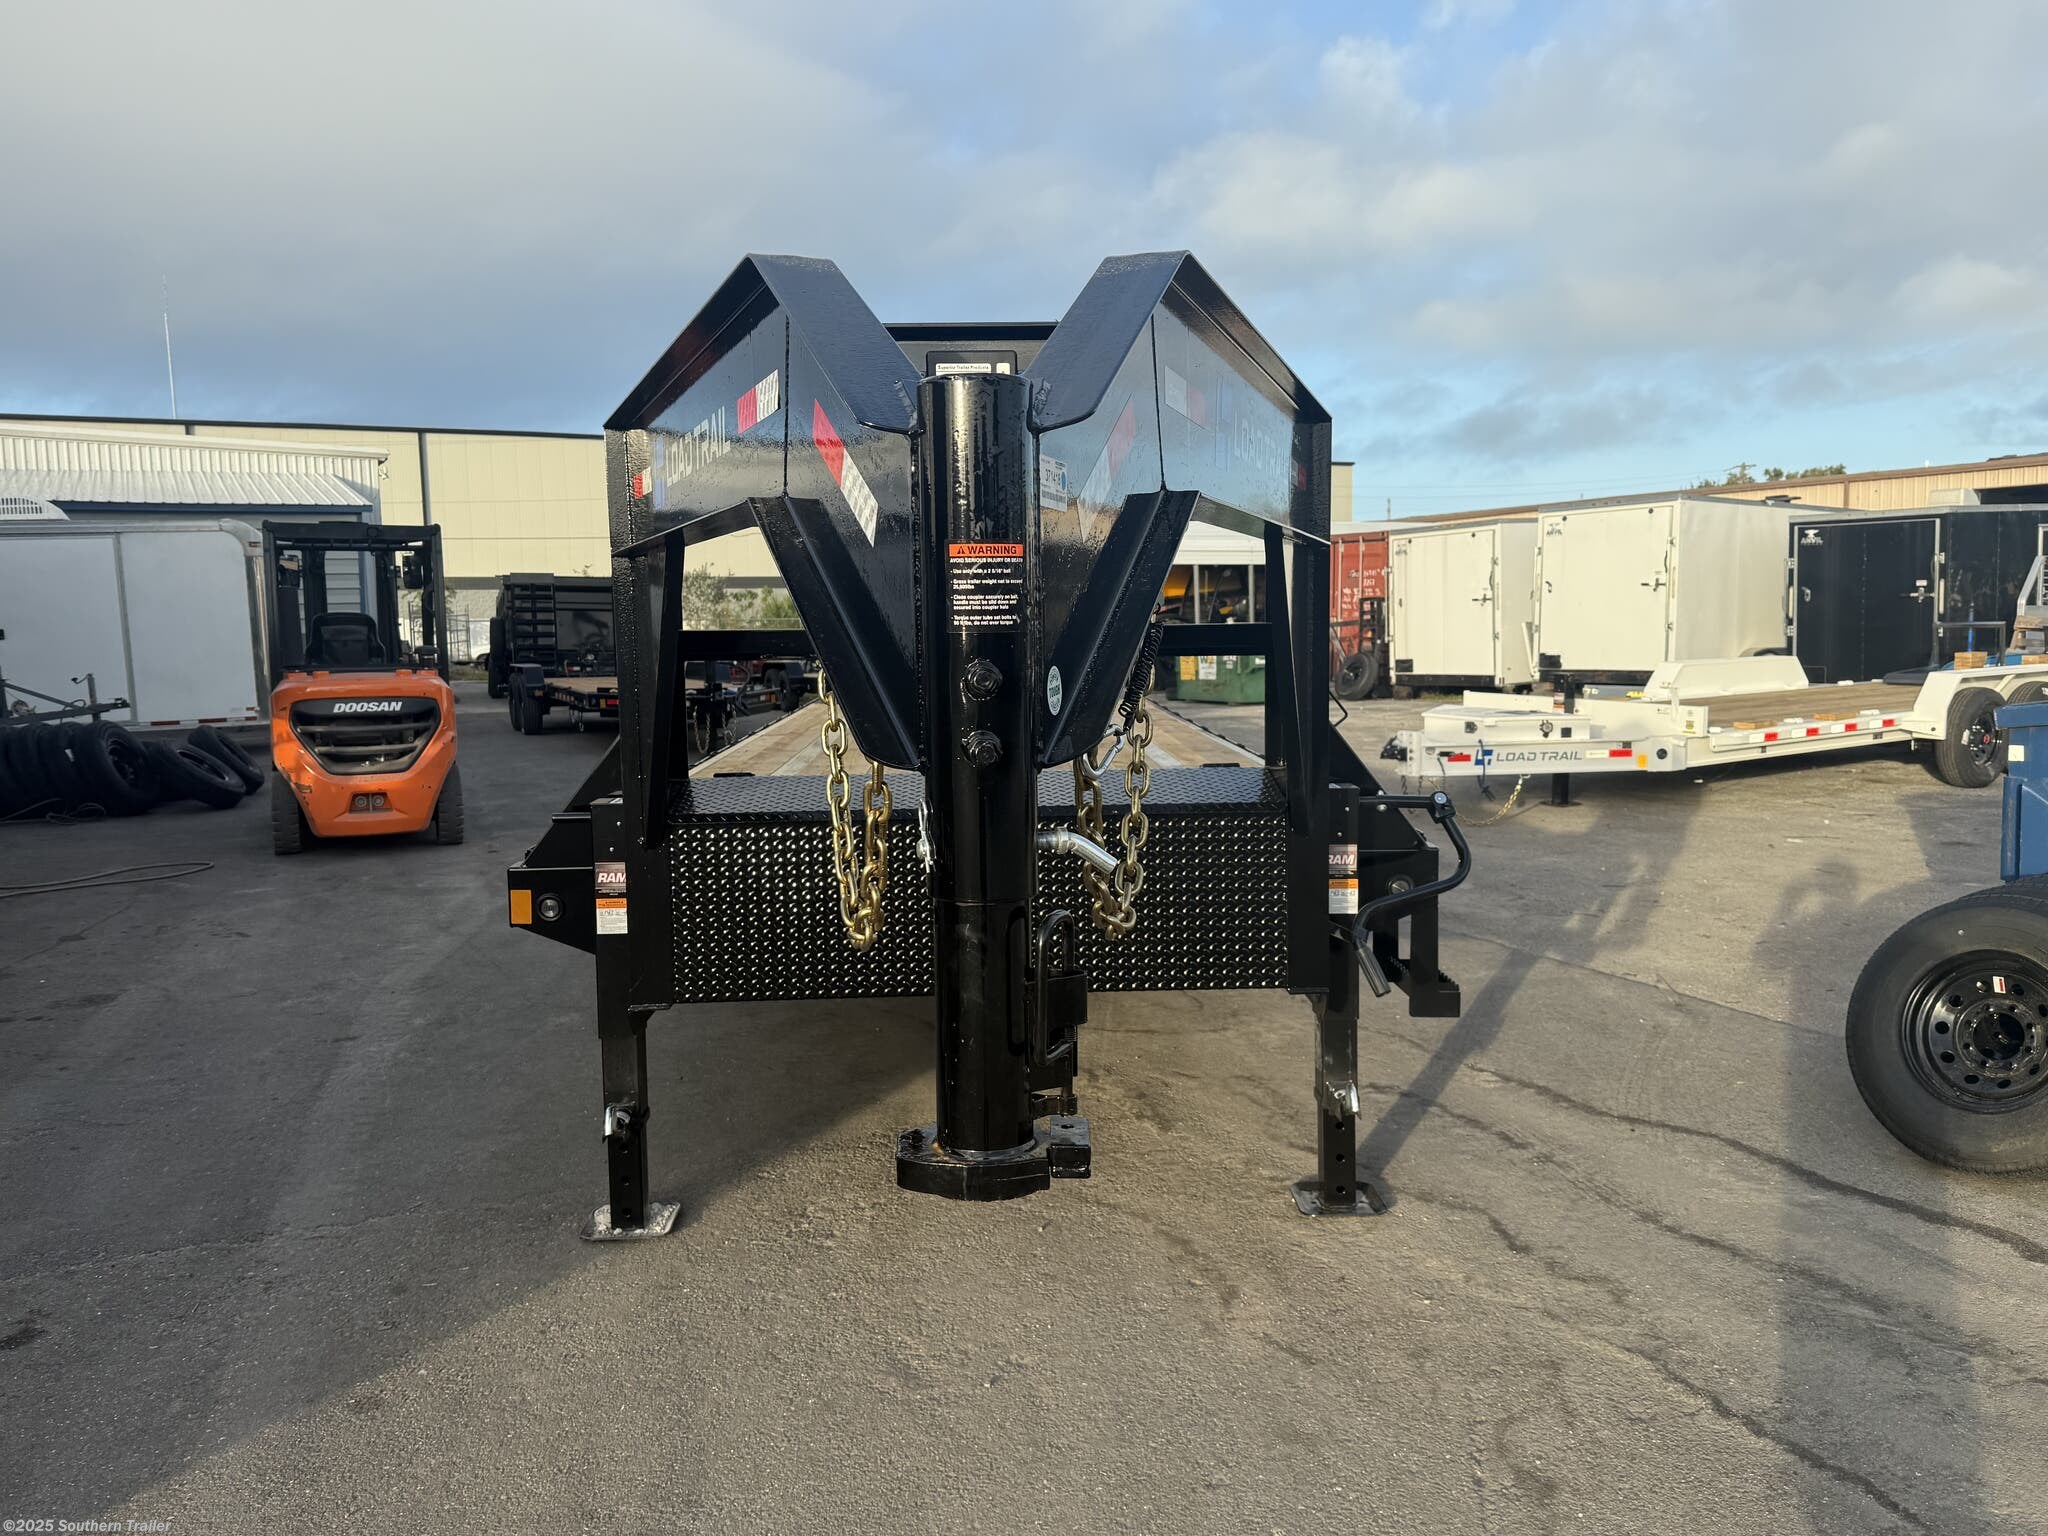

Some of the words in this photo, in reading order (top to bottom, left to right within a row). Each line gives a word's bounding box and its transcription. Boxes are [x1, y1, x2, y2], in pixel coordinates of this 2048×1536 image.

[967, 545, 1017, 555] WARNING
[333, 701, 403, 713] DOOSAN
[1496, 751, 1537, 762] LOAD
[1540, 750, 1583, 761] TRAIL
[1328, 854, 1355, 865] RAM
[597, 872, 627, 884] RAM
